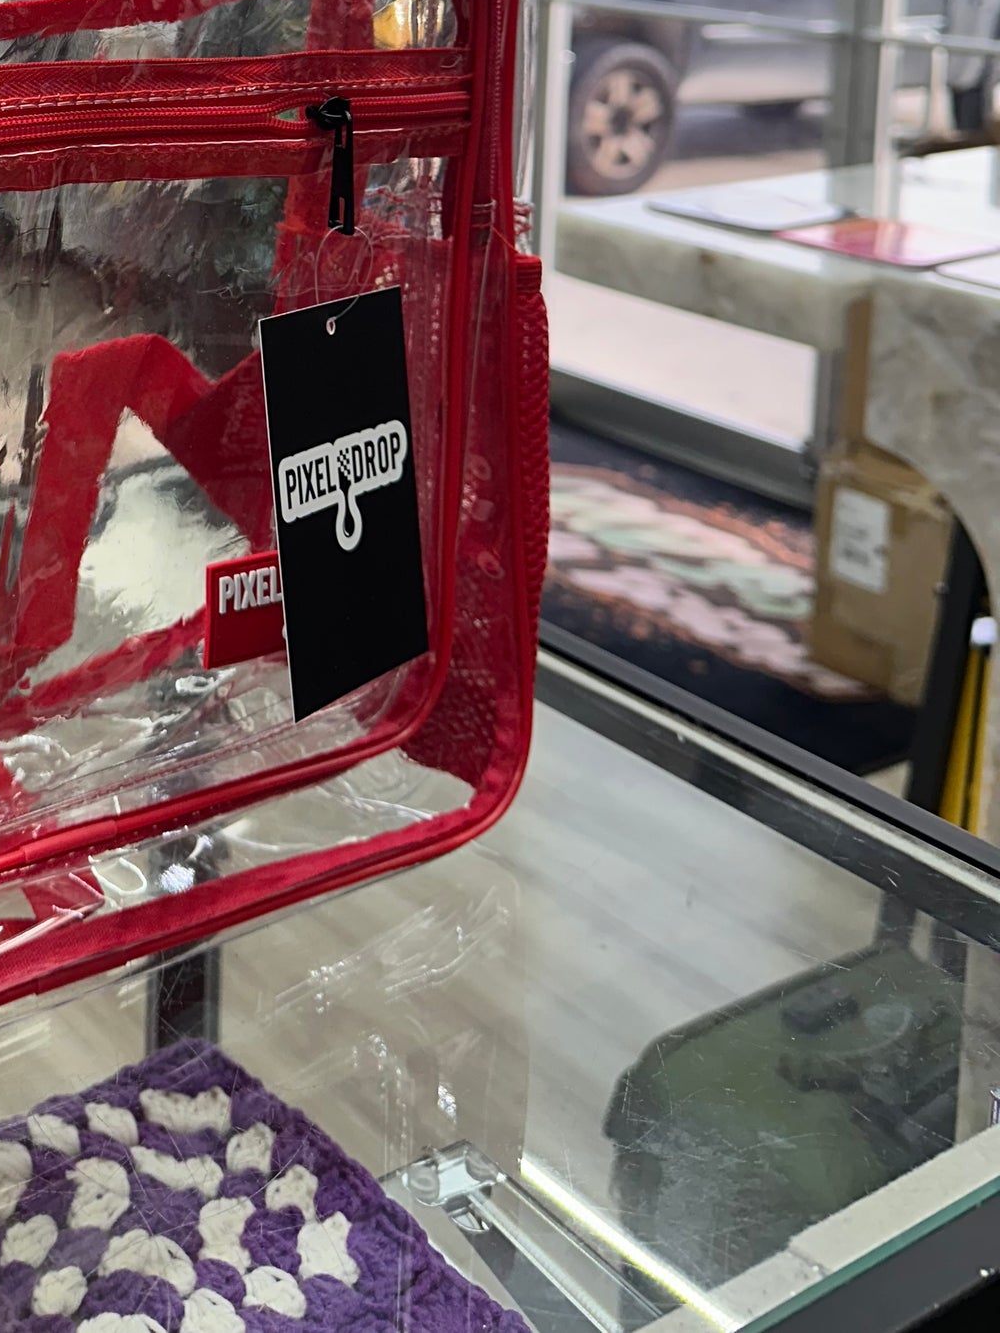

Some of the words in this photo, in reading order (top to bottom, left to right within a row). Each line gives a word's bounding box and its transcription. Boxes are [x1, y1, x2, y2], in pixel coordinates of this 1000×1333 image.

[285, 455, 337, 510] PIXEL
[351, 432, 401, 484] DROP
[218, 566, 283, 615] PIXEL
